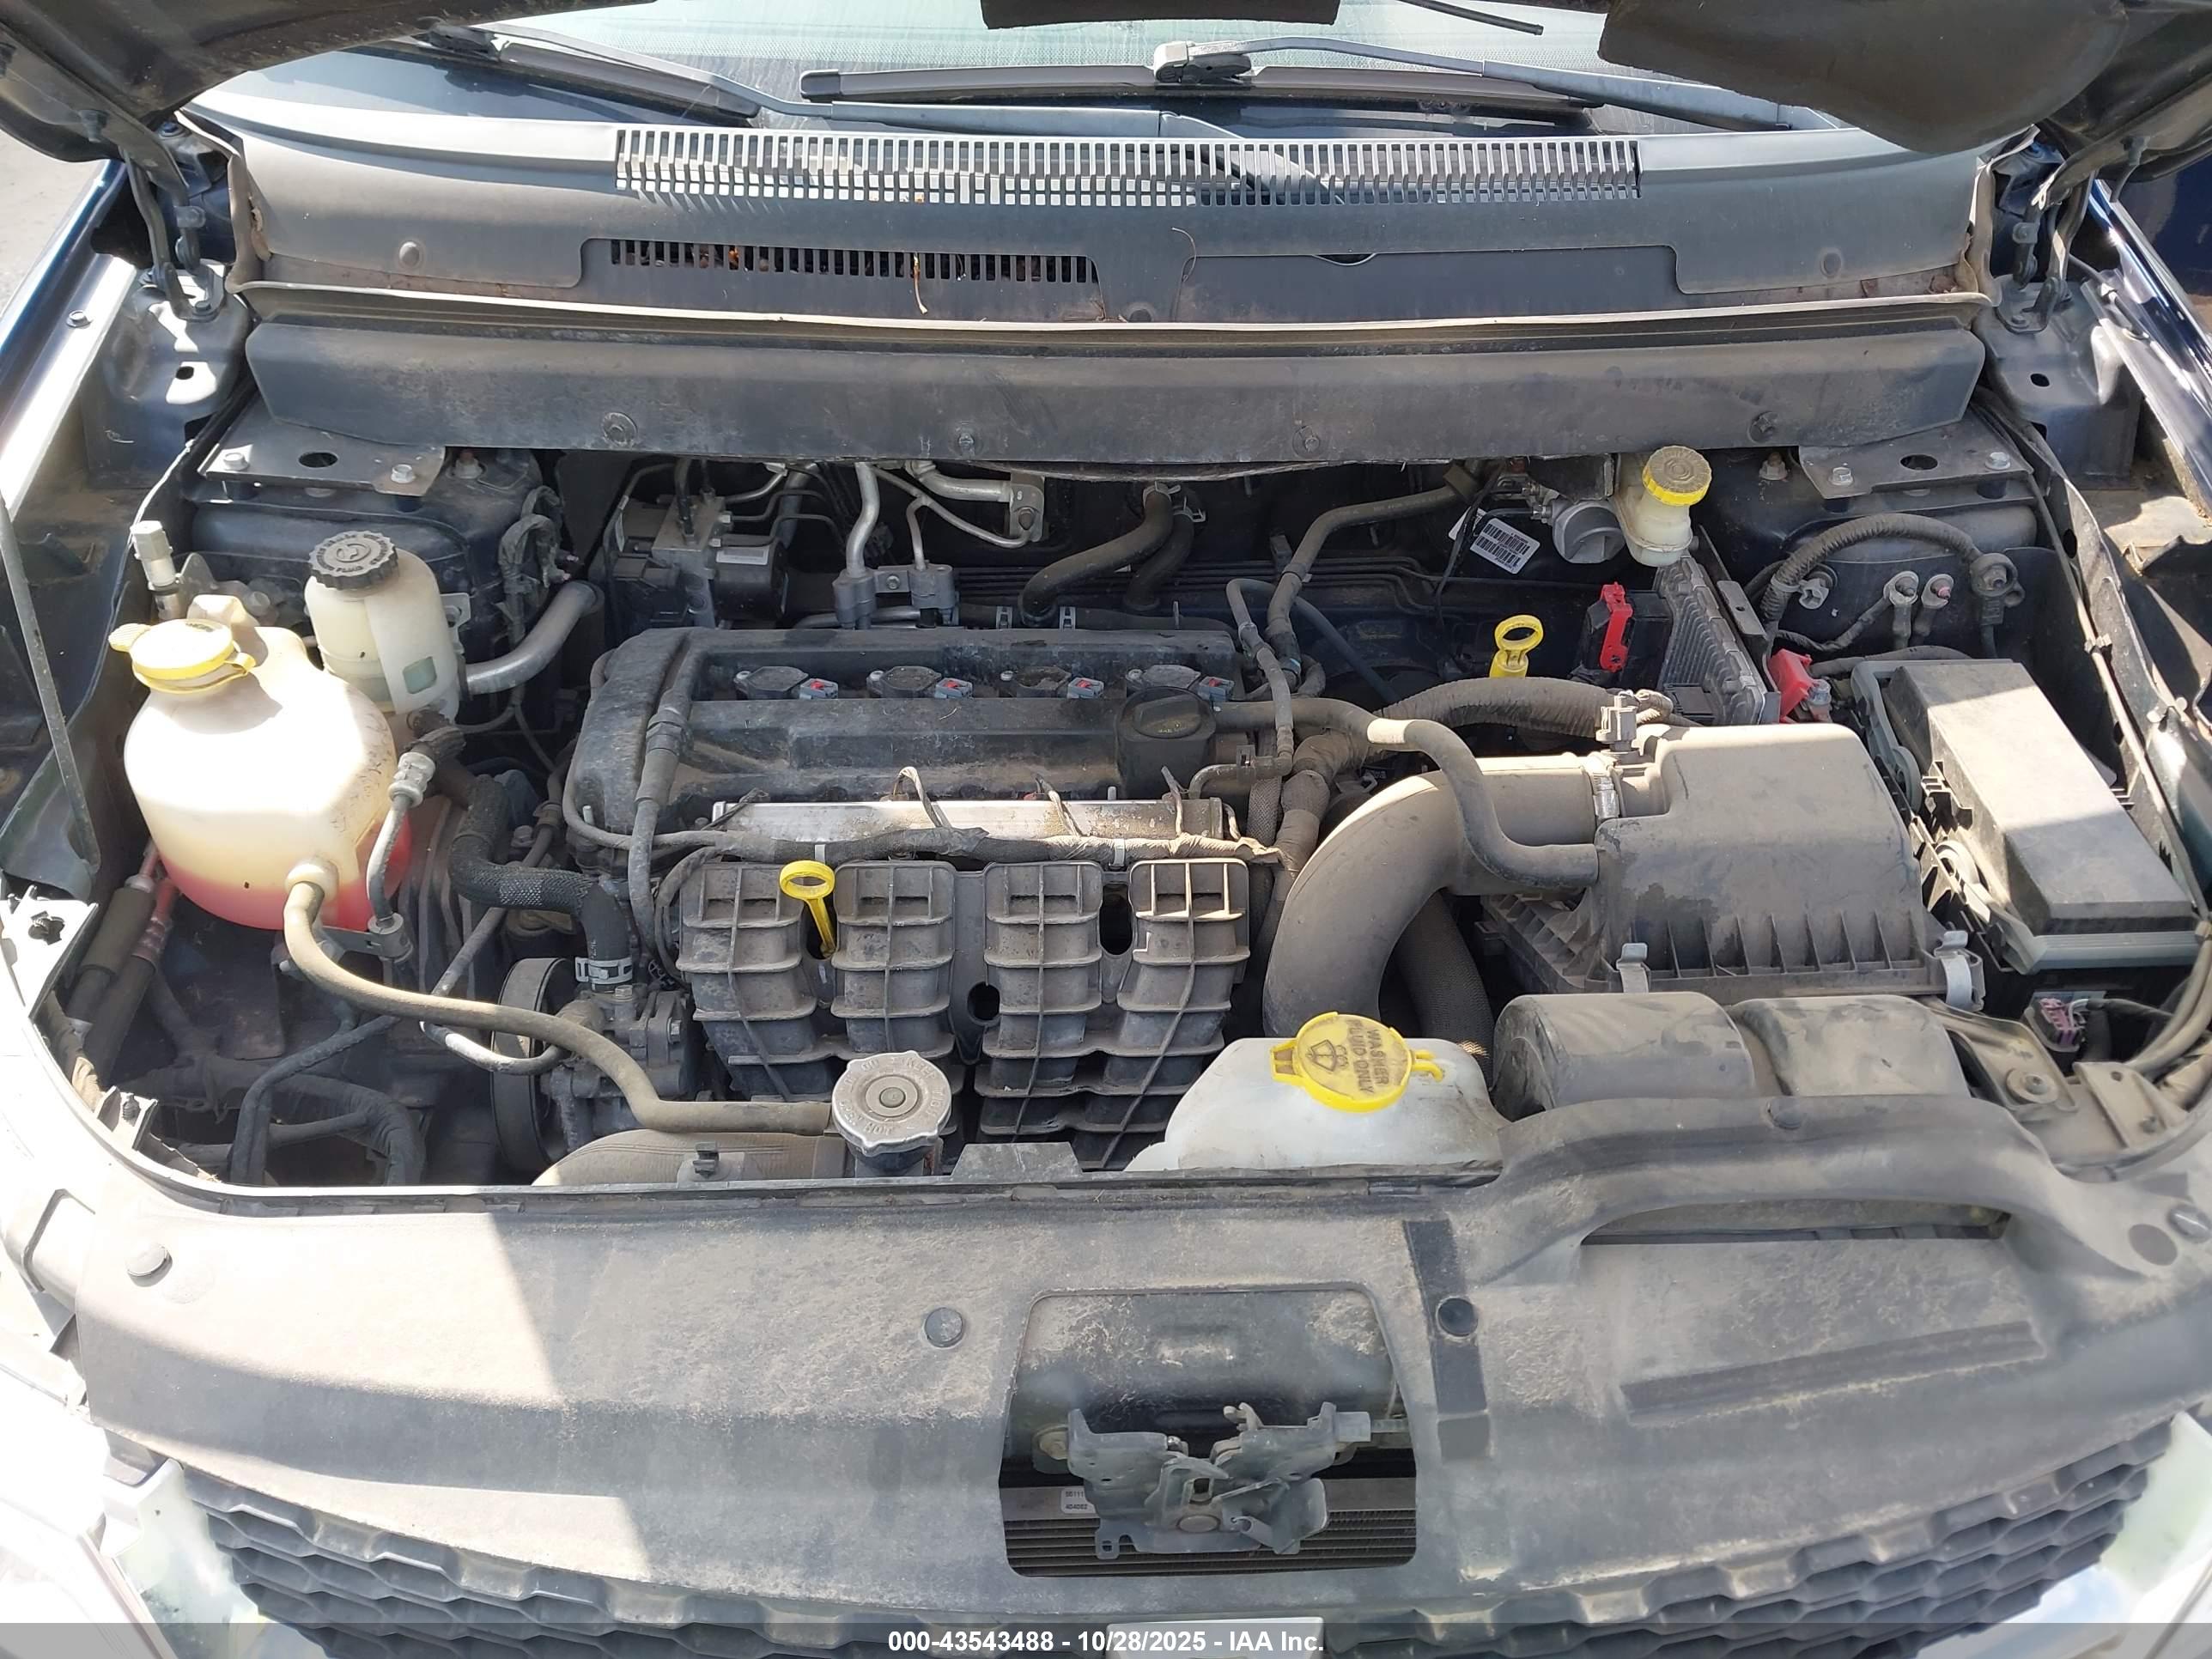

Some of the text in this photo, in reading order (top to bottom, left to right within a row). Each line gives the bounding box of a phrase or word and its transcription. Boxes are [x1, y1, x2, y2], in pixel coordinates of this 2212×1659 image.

[906, 1057, 936, 1079] KEEP
[1346, 1018, 1375, 1094] FLUID ONLY
[1366, 1028, 1390, 1085] WASHER
